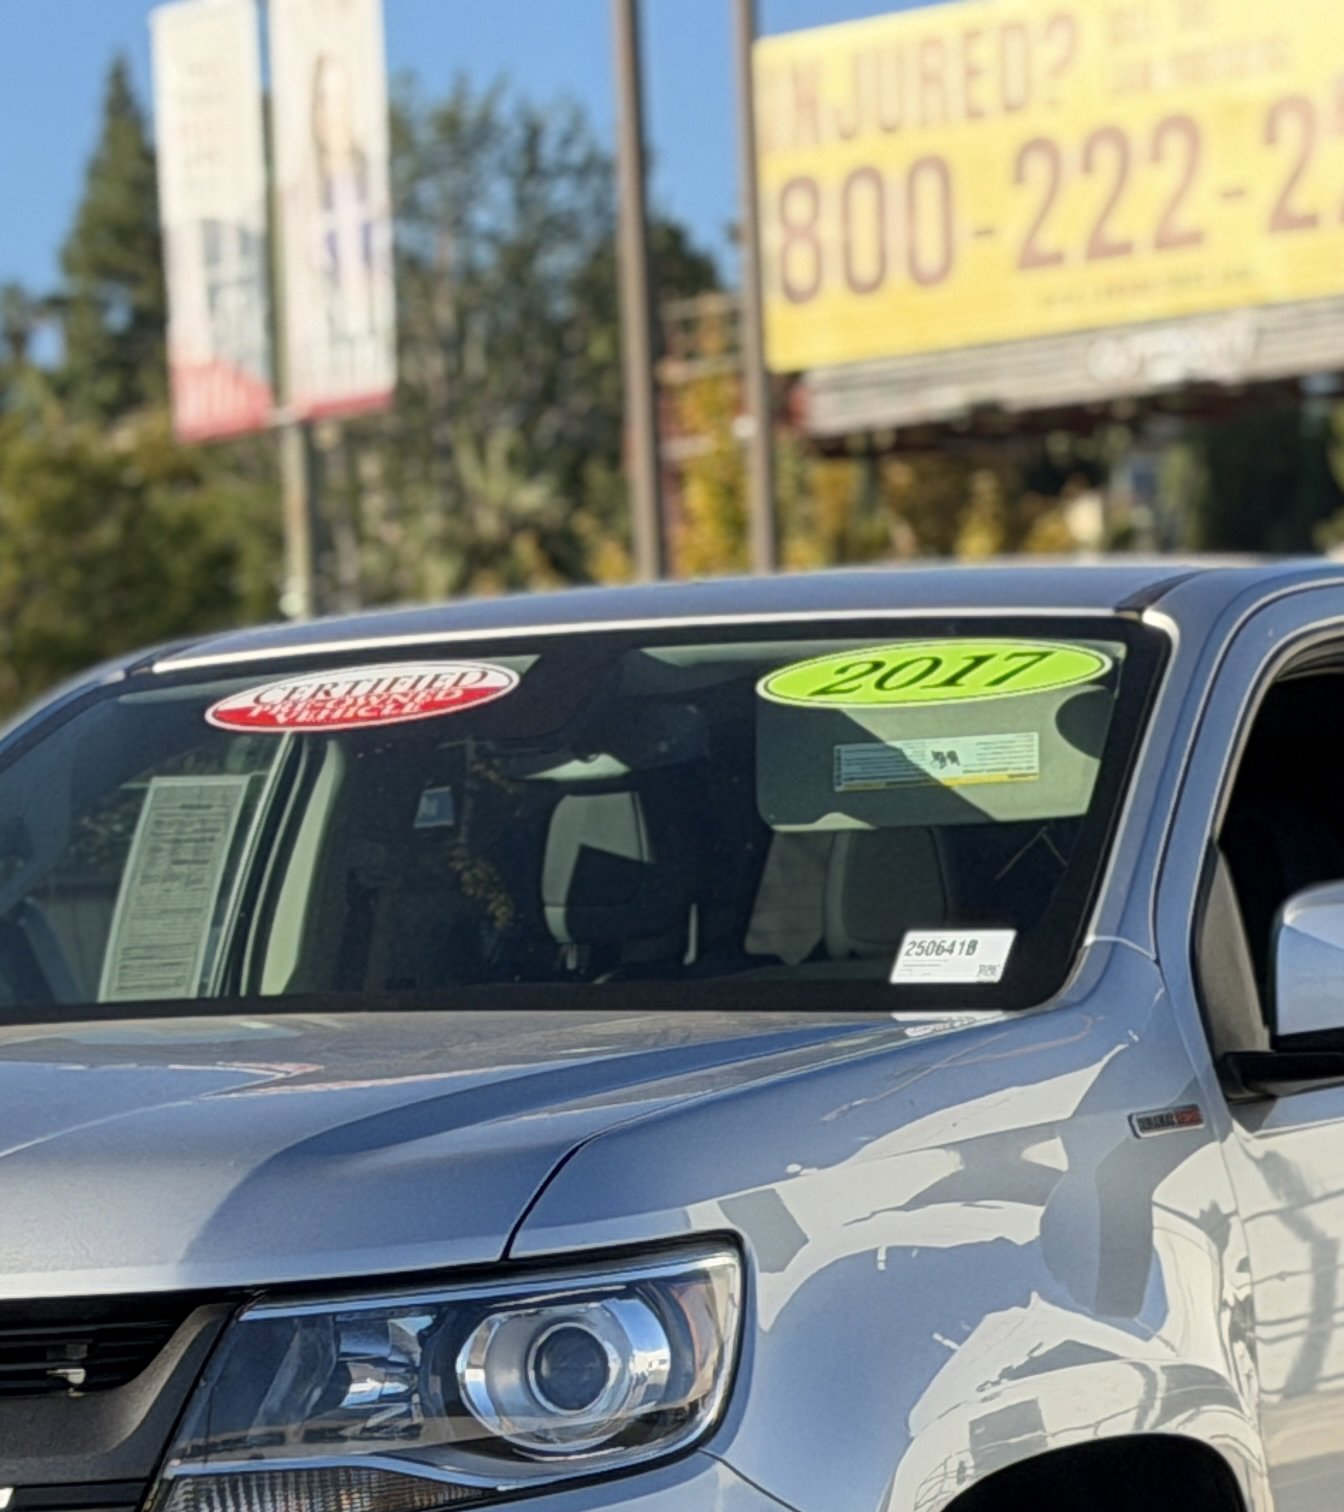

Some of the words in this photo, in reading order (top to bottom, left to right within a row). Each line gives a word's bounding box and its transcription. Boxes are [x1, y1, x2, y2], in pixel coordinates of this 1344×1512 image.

[254, 669, 488, 704] CERTIFIED
[807, 651, 1058, 697] 2017
[249, 688, 464, 717] PRE-OWNED
[275, 701, 425, 724] VEHICLE
